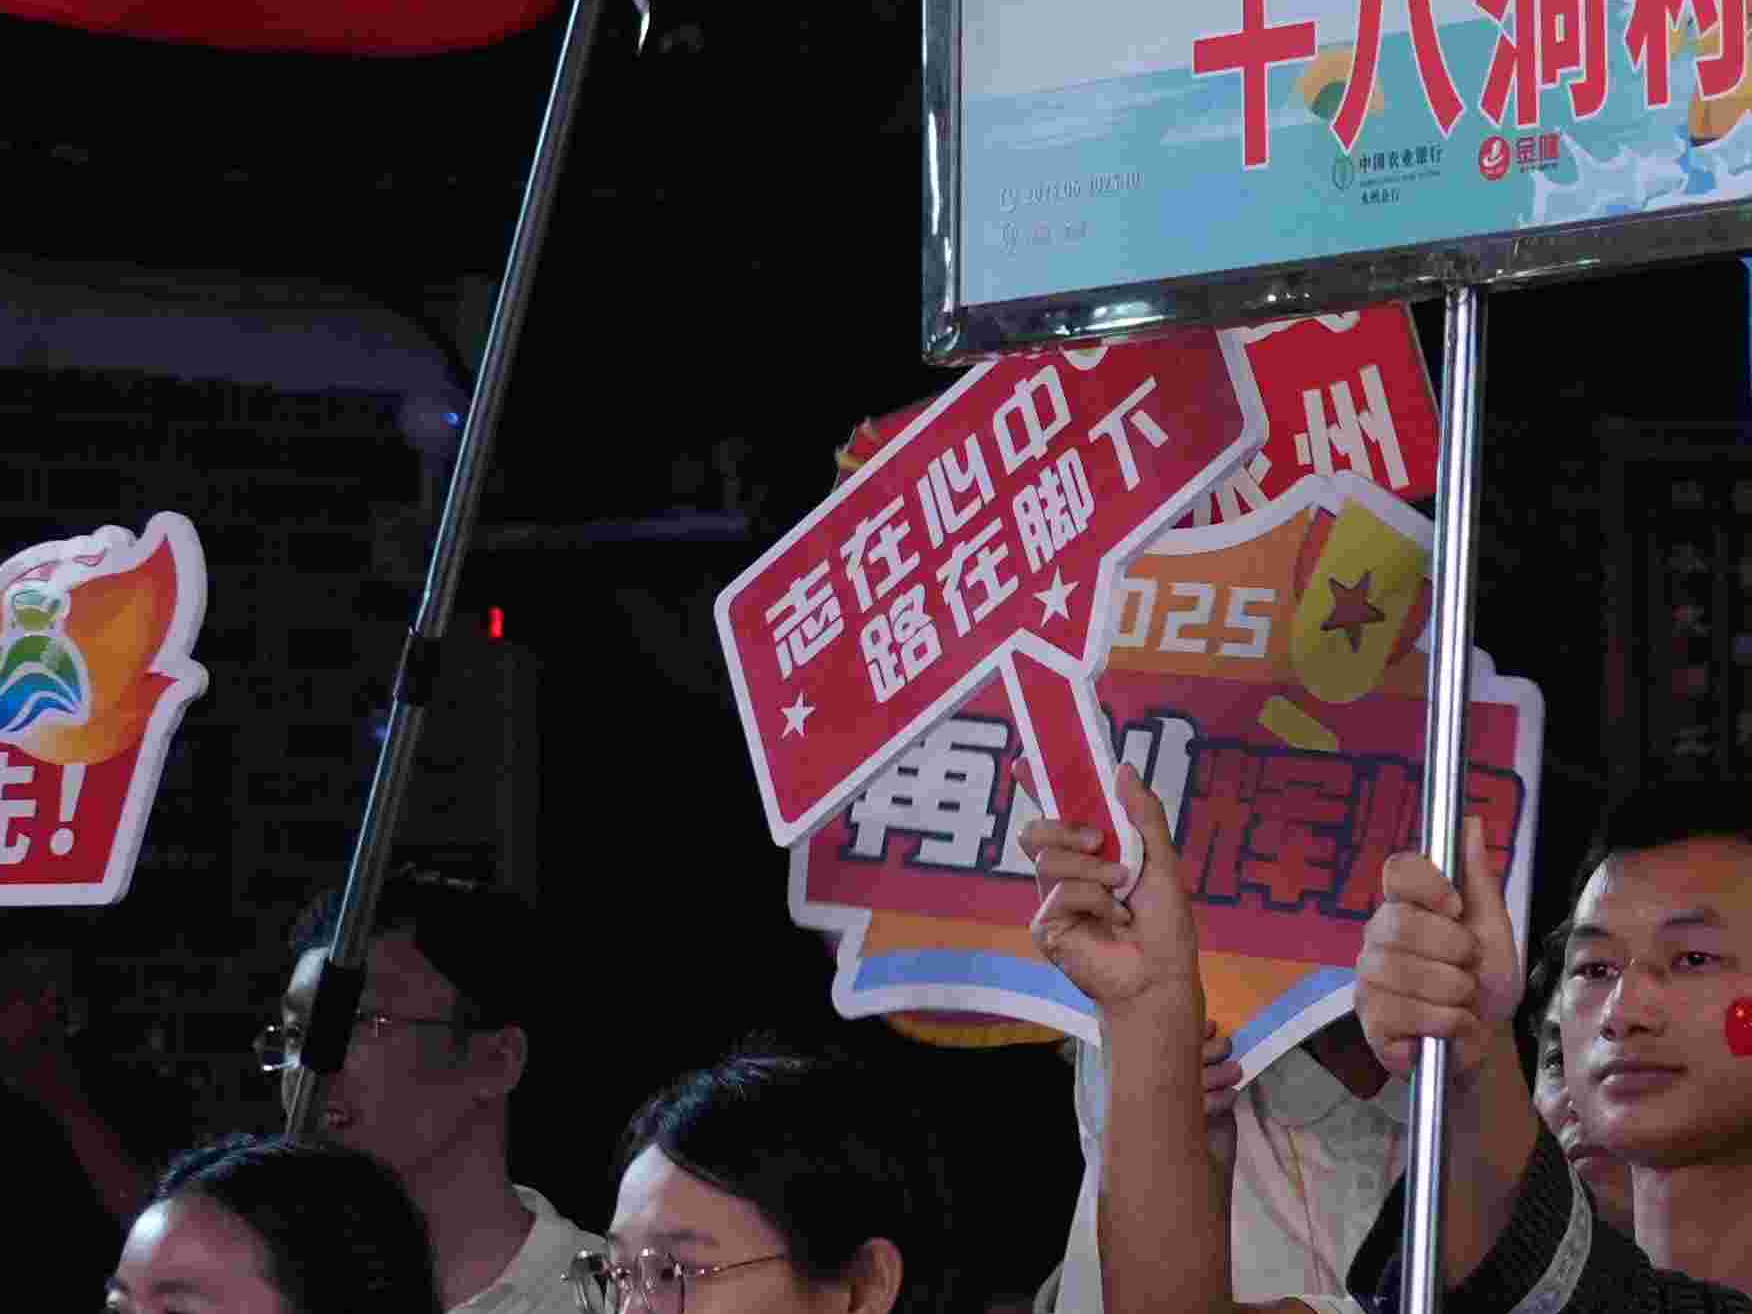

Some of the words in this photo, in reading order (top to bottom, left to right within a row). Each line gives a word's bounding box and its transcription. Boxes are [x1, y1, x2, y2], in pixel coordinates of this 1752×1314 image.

[765, 364, 1072, 679] 志在心中
[860, 376, 1168, 703] 路在脚下
[1109, 575, 1278, 661] 025
